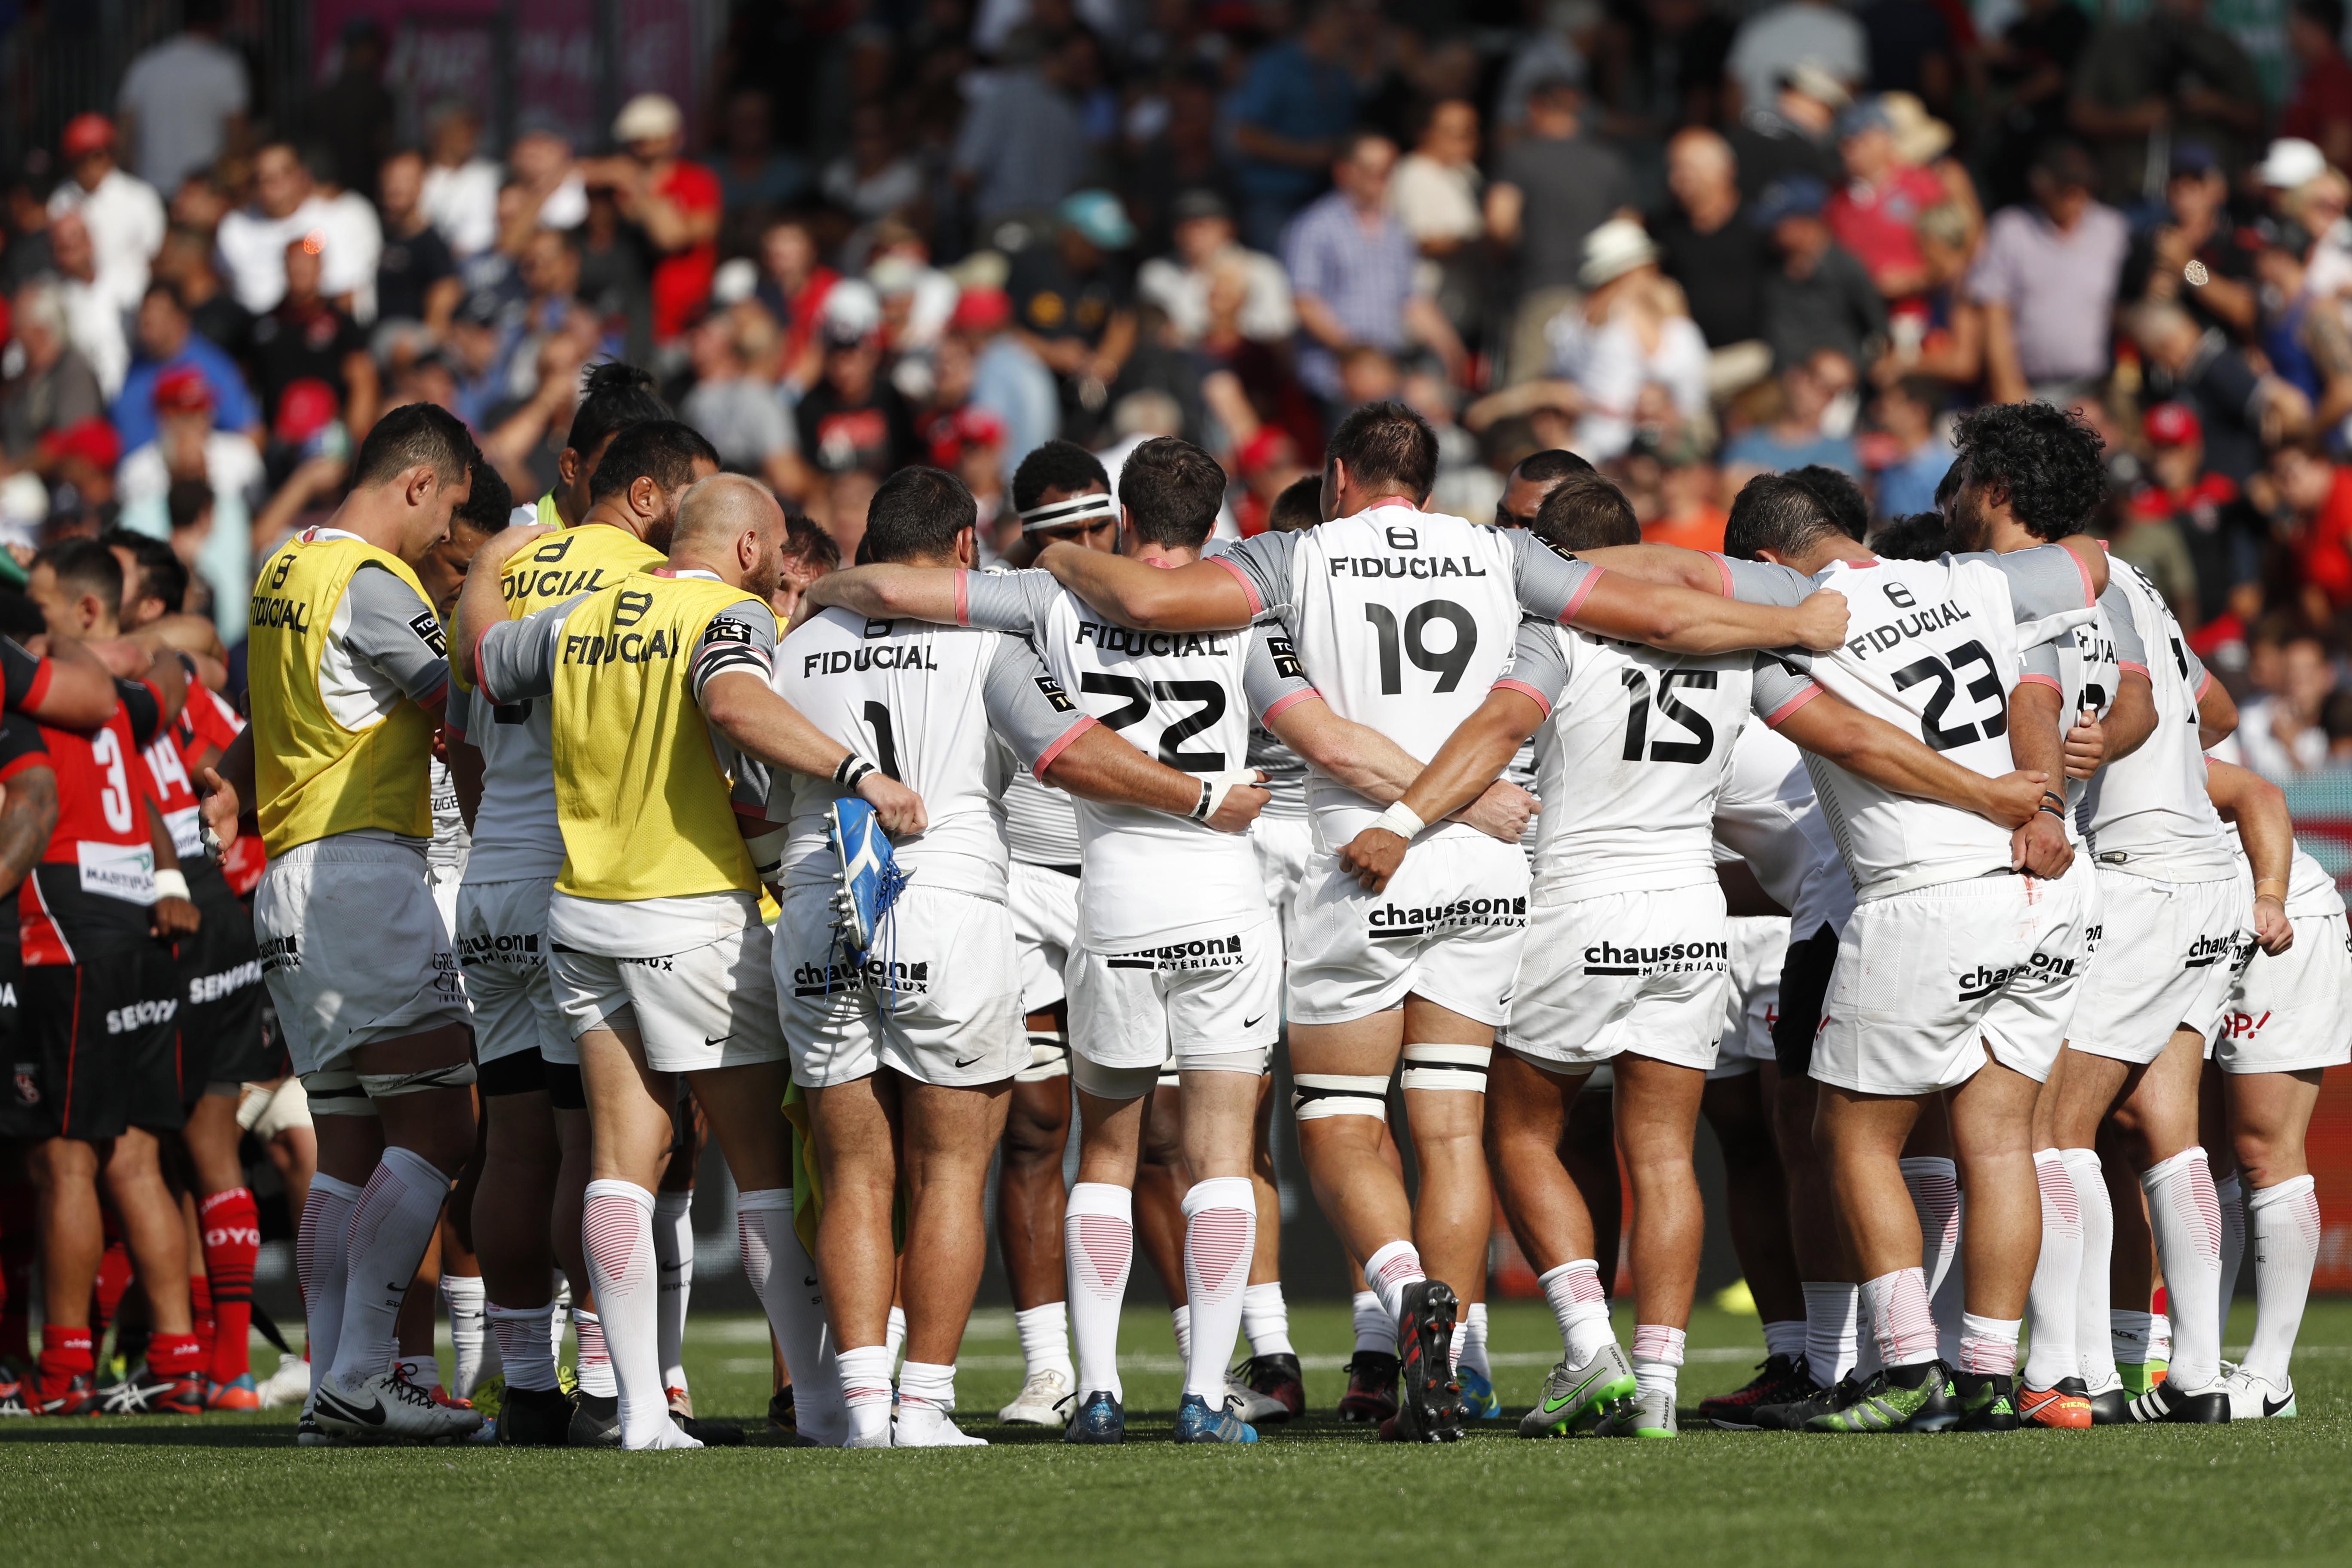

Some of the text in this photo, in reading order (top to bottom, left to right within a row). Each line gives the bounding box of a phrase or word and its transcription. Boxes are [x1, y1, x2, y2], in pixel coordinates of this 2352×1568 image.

[1329, 556, 1486, 579] FIDUCIAL
[712, 628, 743, 640] 14
[1075, 621, 1228, 658] FIDUCIAL
[1847, 599, 1971, 660] FIDUCIAL
[804, 645, 937, 678] FIDUCIAL
[1365, 599, 1478, 695] 19
[1891, 639, 2007, 751] 23
[1081, 672, 1226, 772] 22
[1621, 667, 1718, 764] 15
[864, 700, 900, 782] 1
[91, 727, 133, 834] 3
[144, 731, 193, 801] 14
[1369, 898, 1510, 926] chausson
[1426, 914, 1526, 934] MATÉRIAUX
[1158, 955, 1244, 971] ATÉRIAUX
[1584, 941, 1720, 964] chausson
[1642, 962, 1727, 976] MTÉRIAU
[0, 982, 18, 1008] A
[1609, 1346, 1627, 1375] TIEMPO
[1089, 1409, 1113, 1417] adidas
